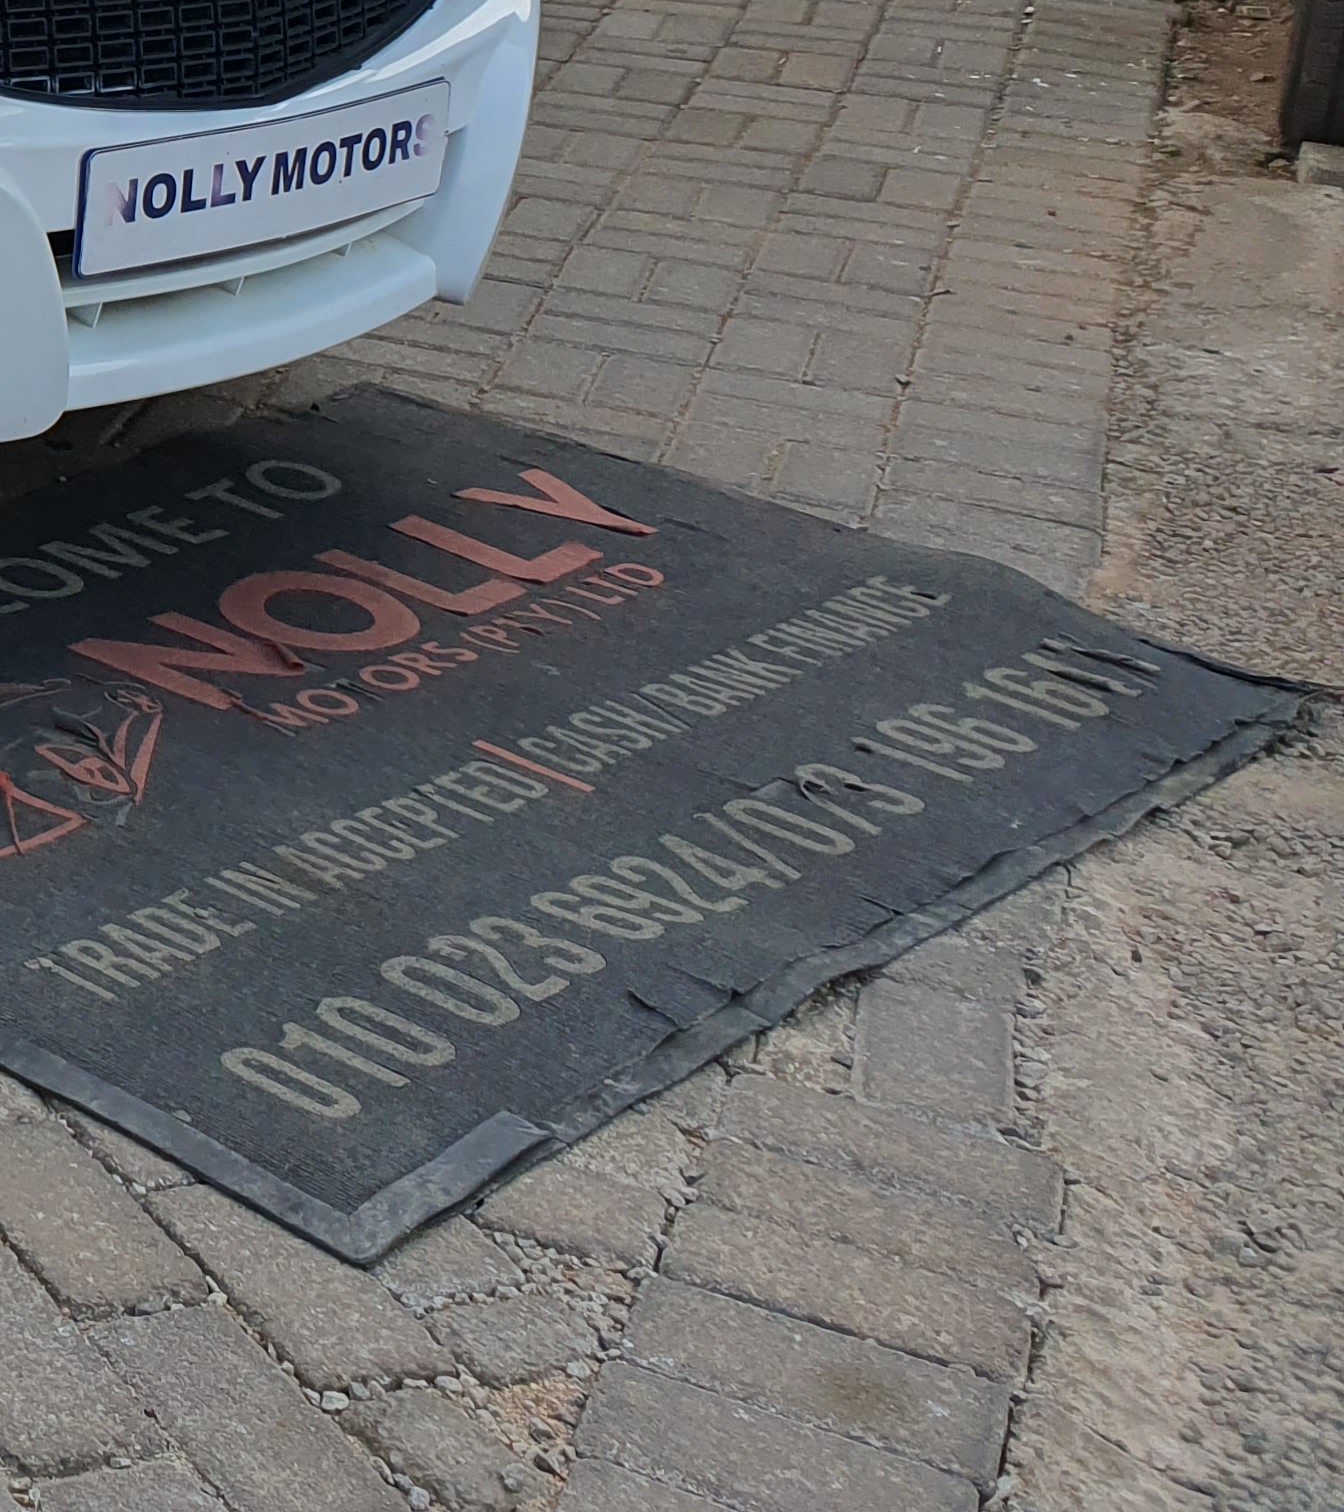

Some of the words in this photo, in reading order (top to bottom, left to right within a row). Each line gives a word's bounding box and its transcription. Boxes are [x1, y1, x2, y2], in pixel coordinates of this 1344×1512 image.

[106, 155, 267, 226] NOLLY
[269, 112, 439, 196] MOTORS
[185, 459, 342, 520] TO
[67, 467, 661, 711] NOLLY
[566, 562, 665, 606] LTD
[23, 887, 258, 1003] TRADE
[204, 859, 316, 918] IN
[746, 575, 953, 667] FINANCE
[220, 995, 457, 1119] 010
[379, 915, 609, 1028] 023
[850, 702, 1039, 784] 196
